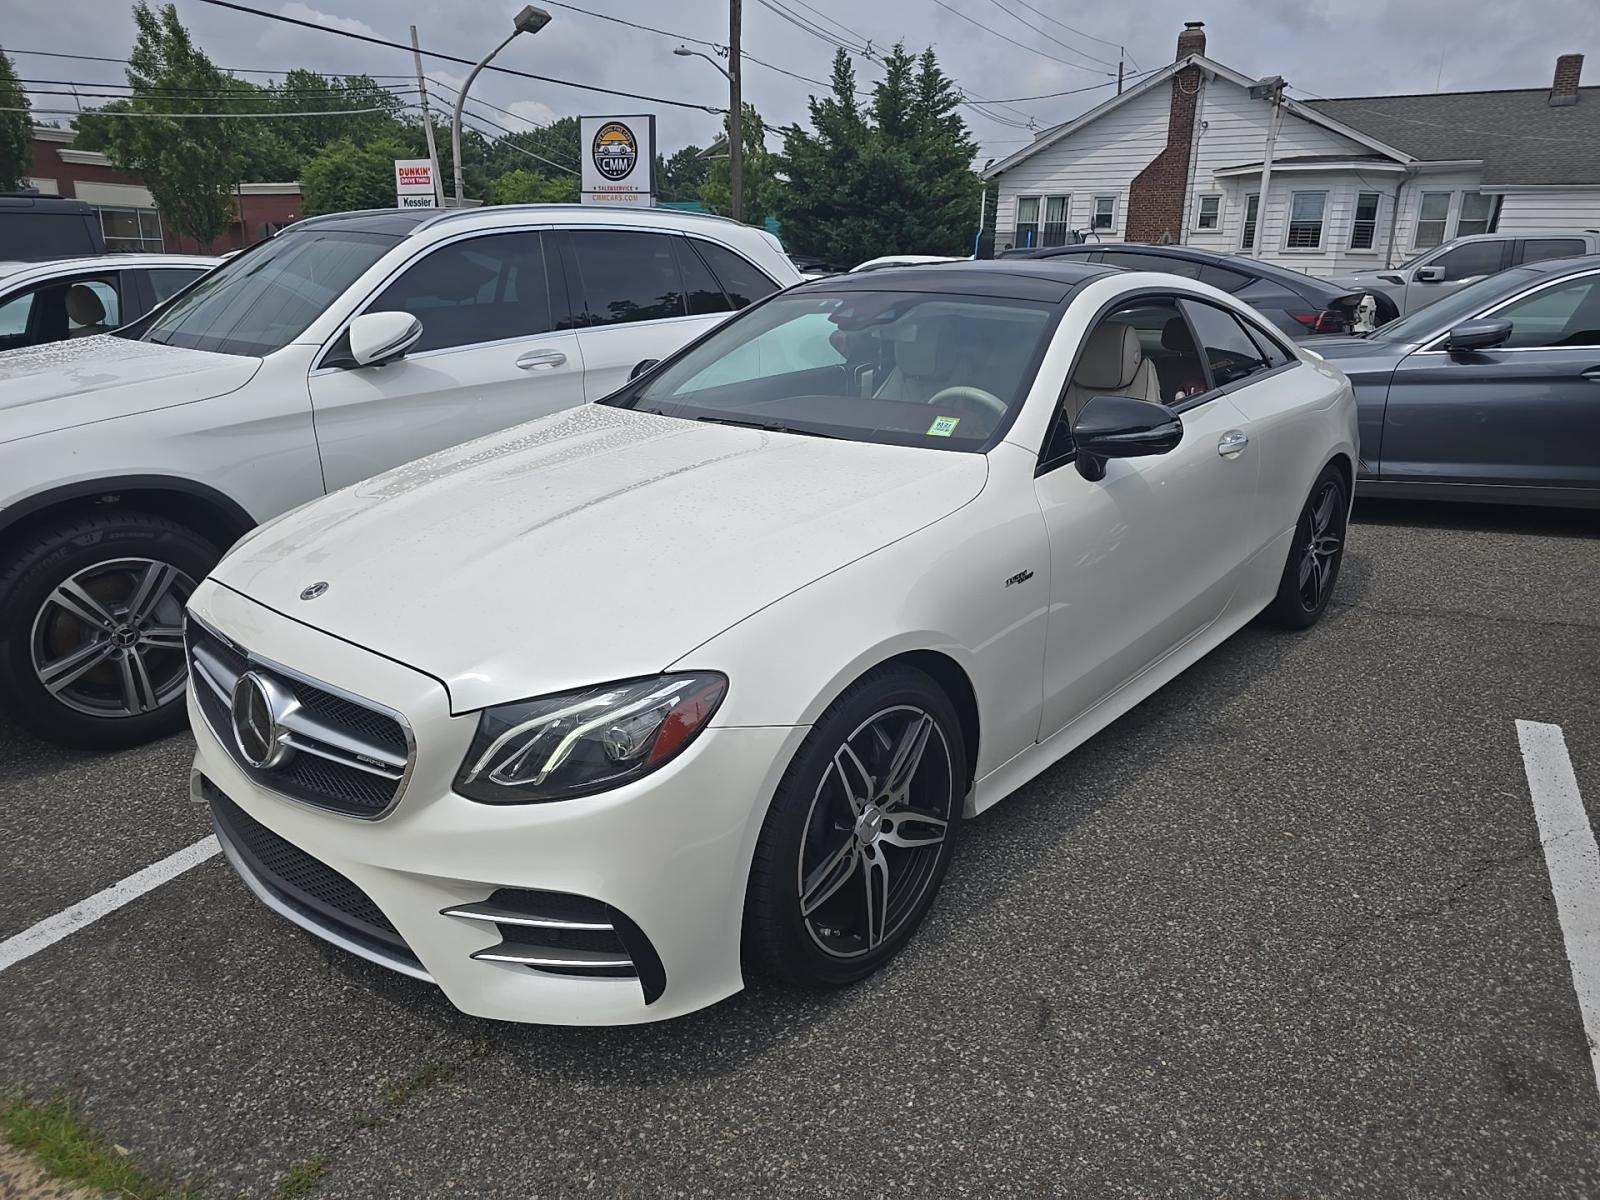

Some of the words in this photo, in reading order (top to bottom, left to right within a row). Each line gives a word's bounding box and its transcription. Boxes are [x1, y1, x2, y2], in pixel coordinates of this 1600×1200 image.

[602, 158, 628, 171] CMM
[399, 167, 431, 176] DUNKIN'
[403, 197, 432, 207] Kessler
